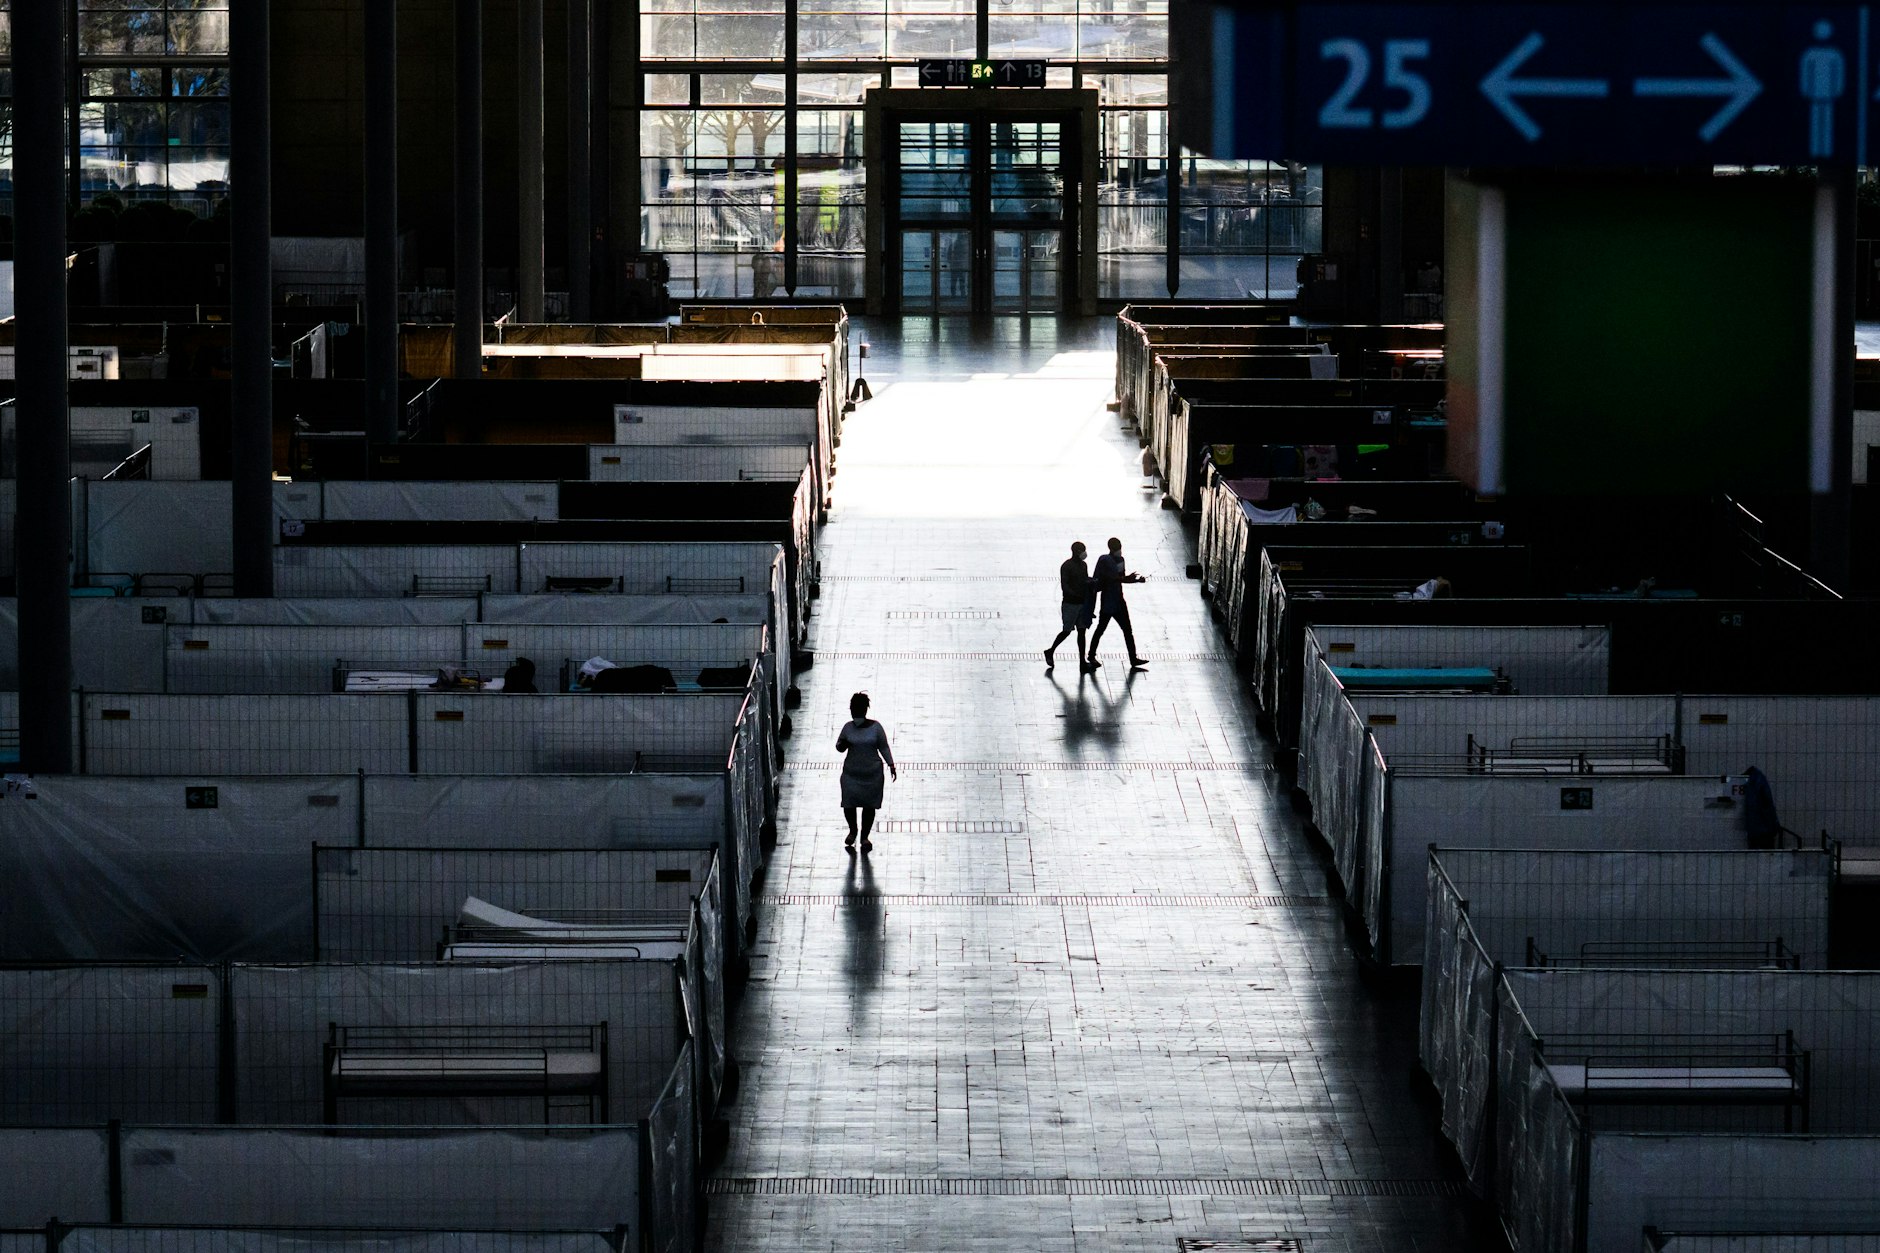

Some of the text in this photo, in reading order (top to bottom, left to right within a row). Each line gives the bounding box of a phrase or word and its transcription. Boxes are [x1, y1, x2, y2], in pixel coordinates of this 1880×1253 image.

[1025, 63, 1043, 79] 13
[1317, 37, 1434, 130] 25
[7, 781, 21, 792] F7
[1732, 784, 1746, 796] F8
